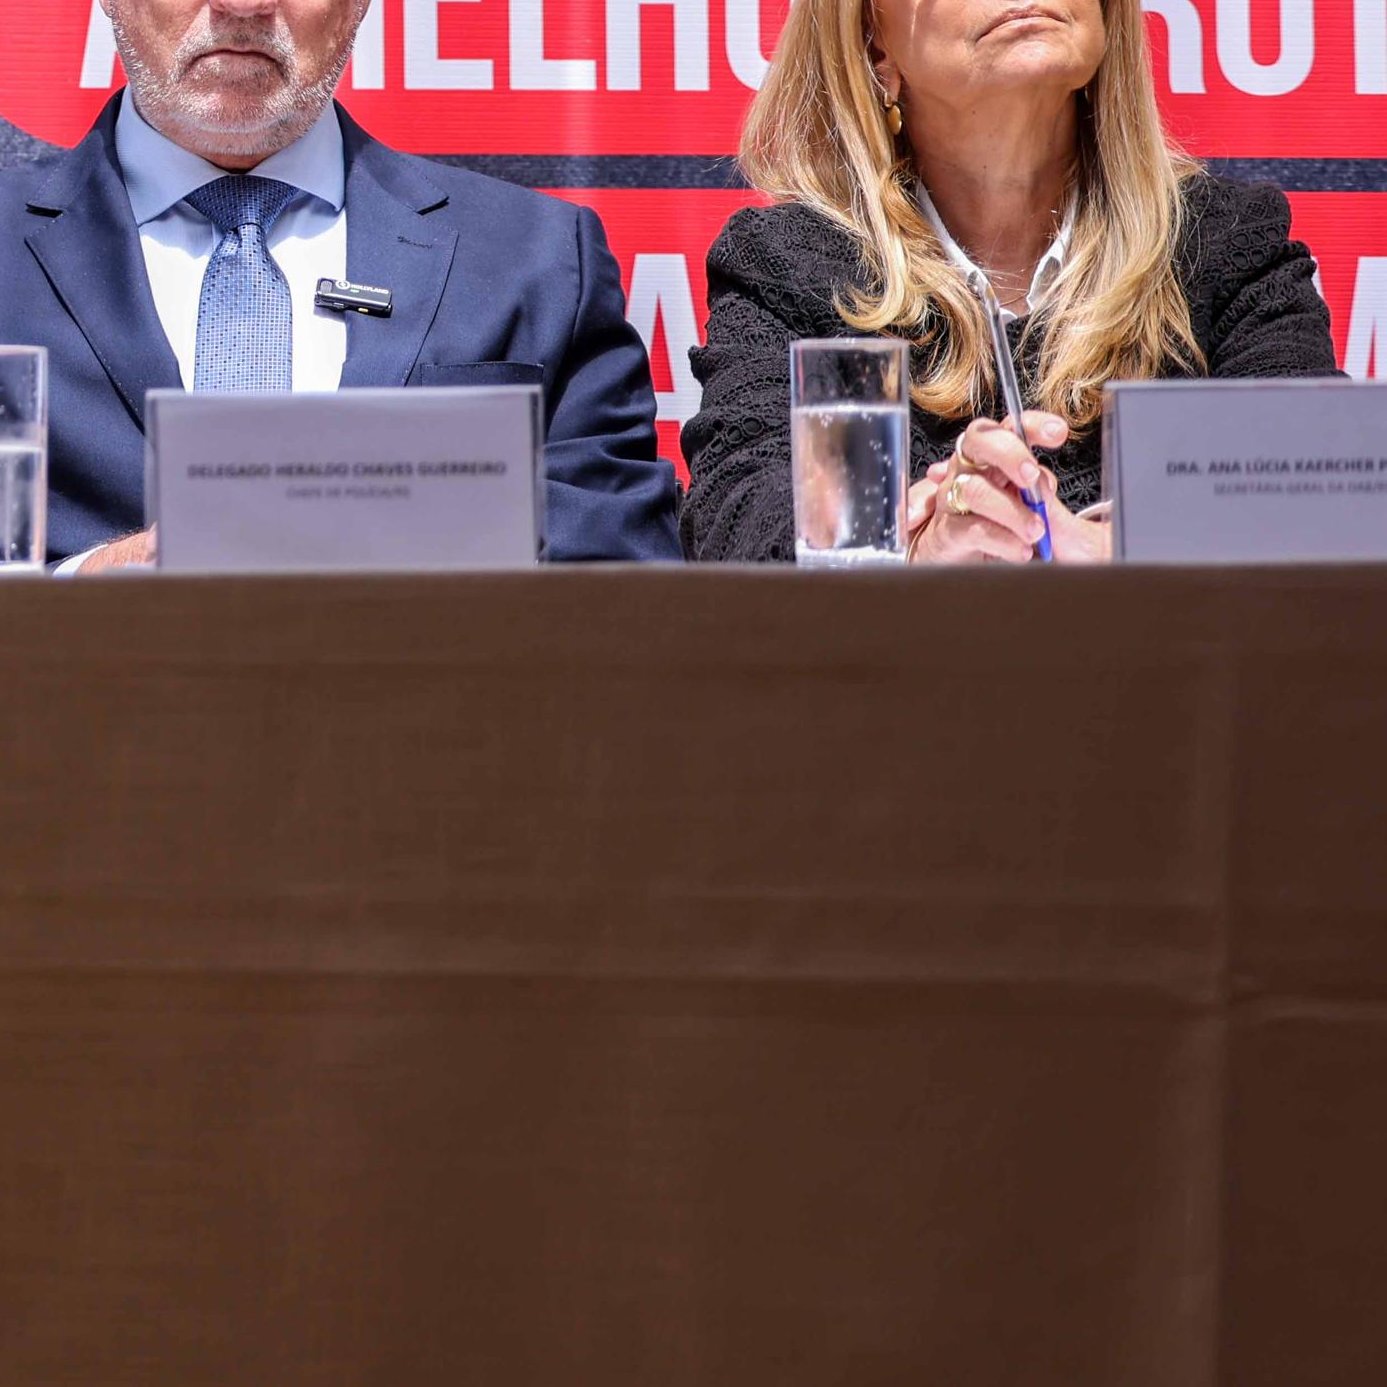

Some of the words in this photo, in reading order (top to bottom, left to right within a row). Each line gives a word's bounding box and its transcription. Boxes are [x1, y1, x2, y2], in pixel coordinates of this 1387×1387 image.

[1165, 460, 1202, 476] DRA.
[1207, 460, 1242, 475] ANA
[1245, 456, 1291, 474] LÚCIA
